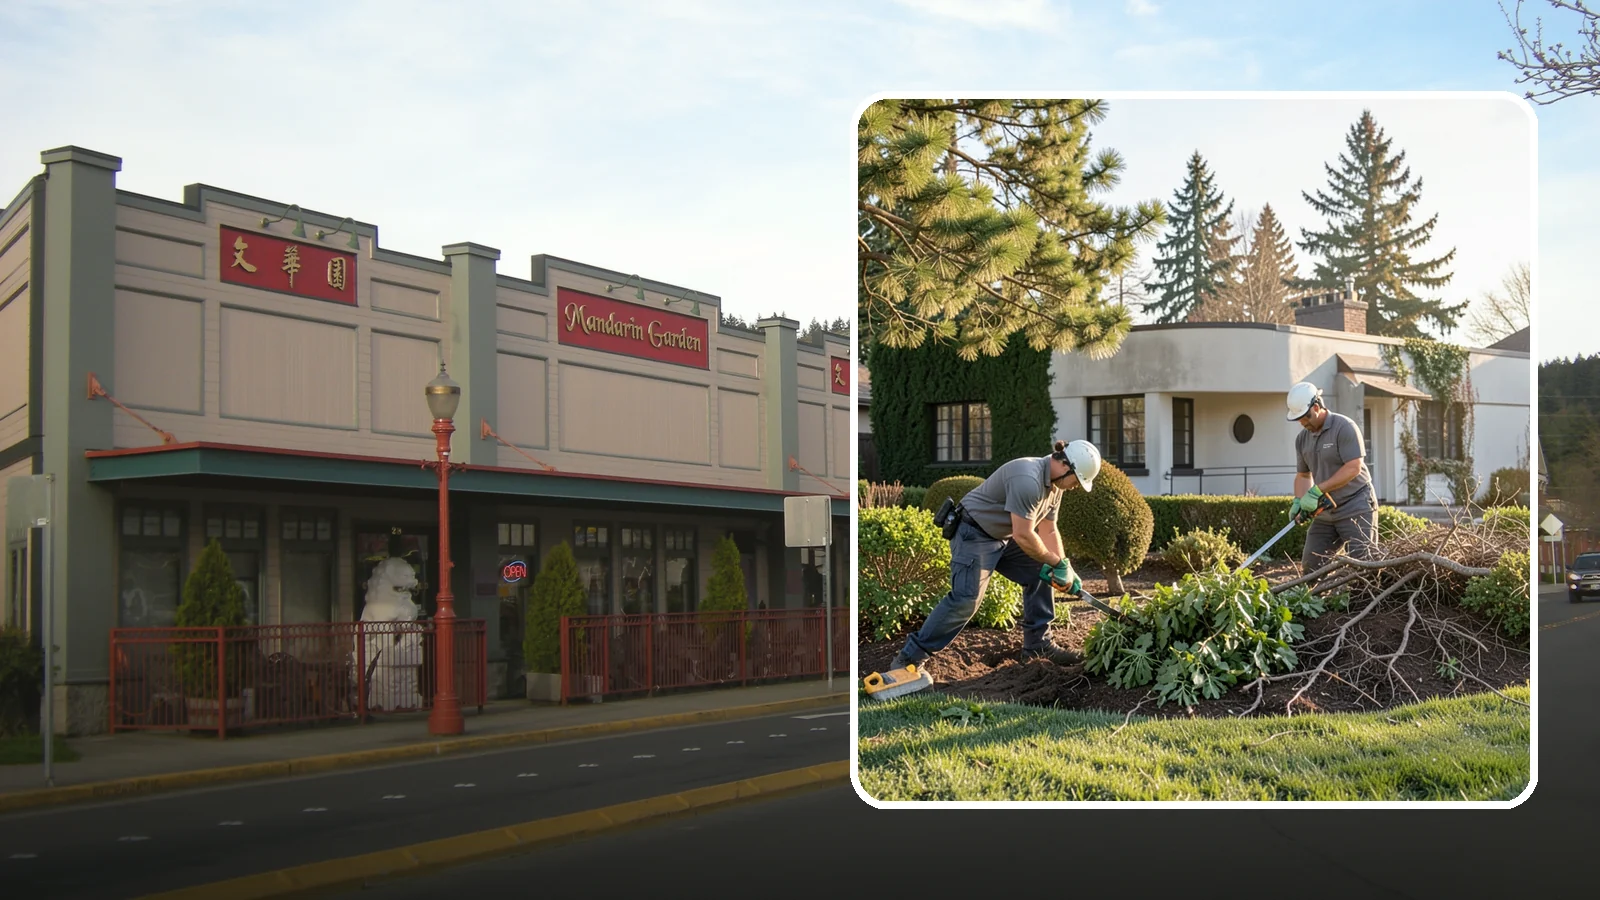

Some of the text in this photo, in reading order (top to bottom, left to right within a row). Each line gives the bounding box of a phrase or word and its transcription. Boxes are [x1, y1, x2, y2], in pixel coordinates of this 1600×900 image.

[231, 236, 346, 291] 文華園
[564, 302, 701, 352] Mandarin Garden
[503, 565, 527, 578] OPEN
